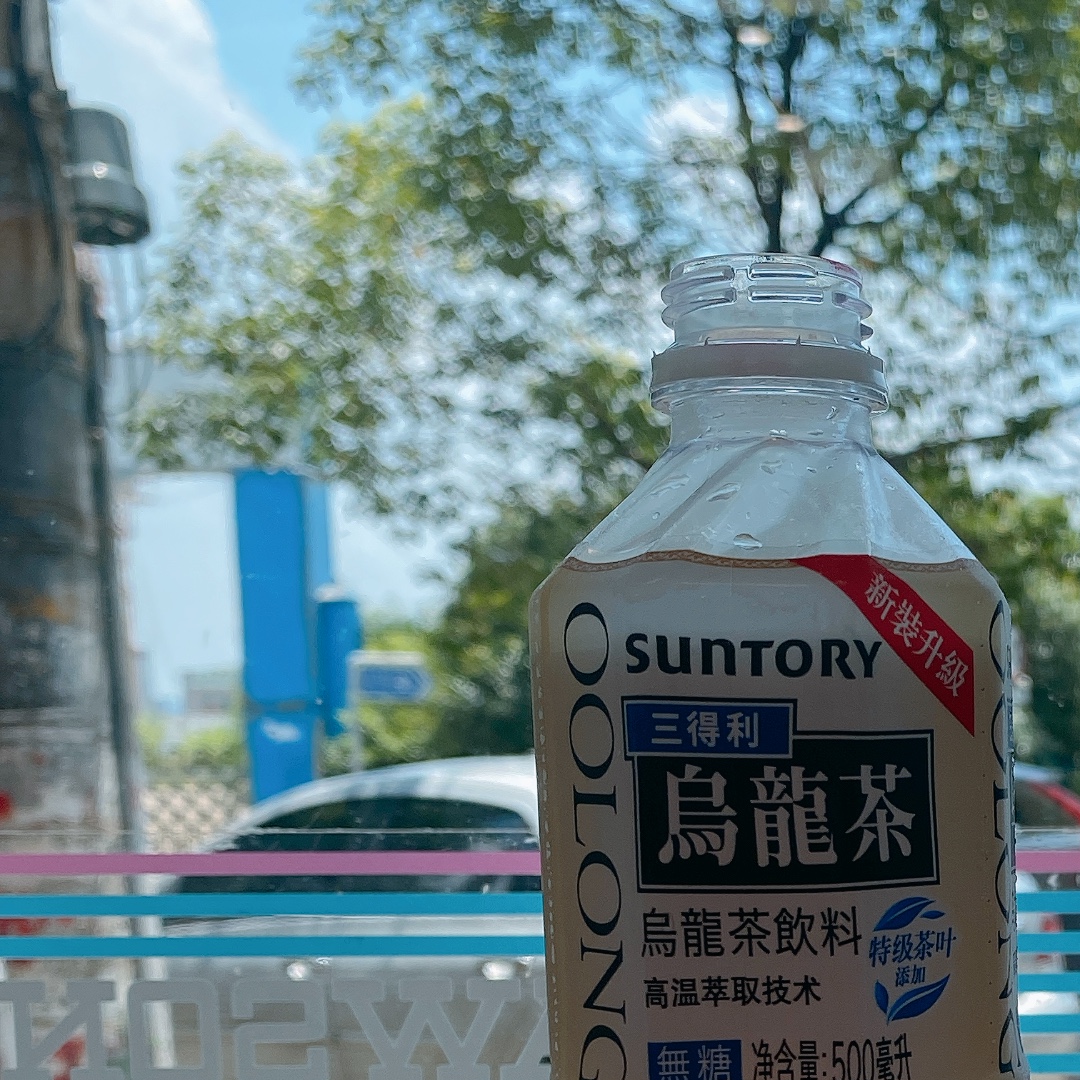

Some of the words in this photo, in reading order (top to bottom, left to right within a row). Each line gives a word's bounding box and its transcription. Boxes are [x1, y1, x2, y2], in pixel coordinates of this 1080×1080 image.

[625, 632, 882, 680] SUNTORY
[865, 571, 969, 697] 新裝升級
[651, 711, 759, 748] 三得利
[658, 764, 915, 867] 烏龍茶
[642, 906, 862, 957] 烏龍茶飲料
[868, 927, 957, 967] 特级茶叶
[644, 975, 821, 1009] 高温萃取技术
[895, 964, 926, 987] 添加
